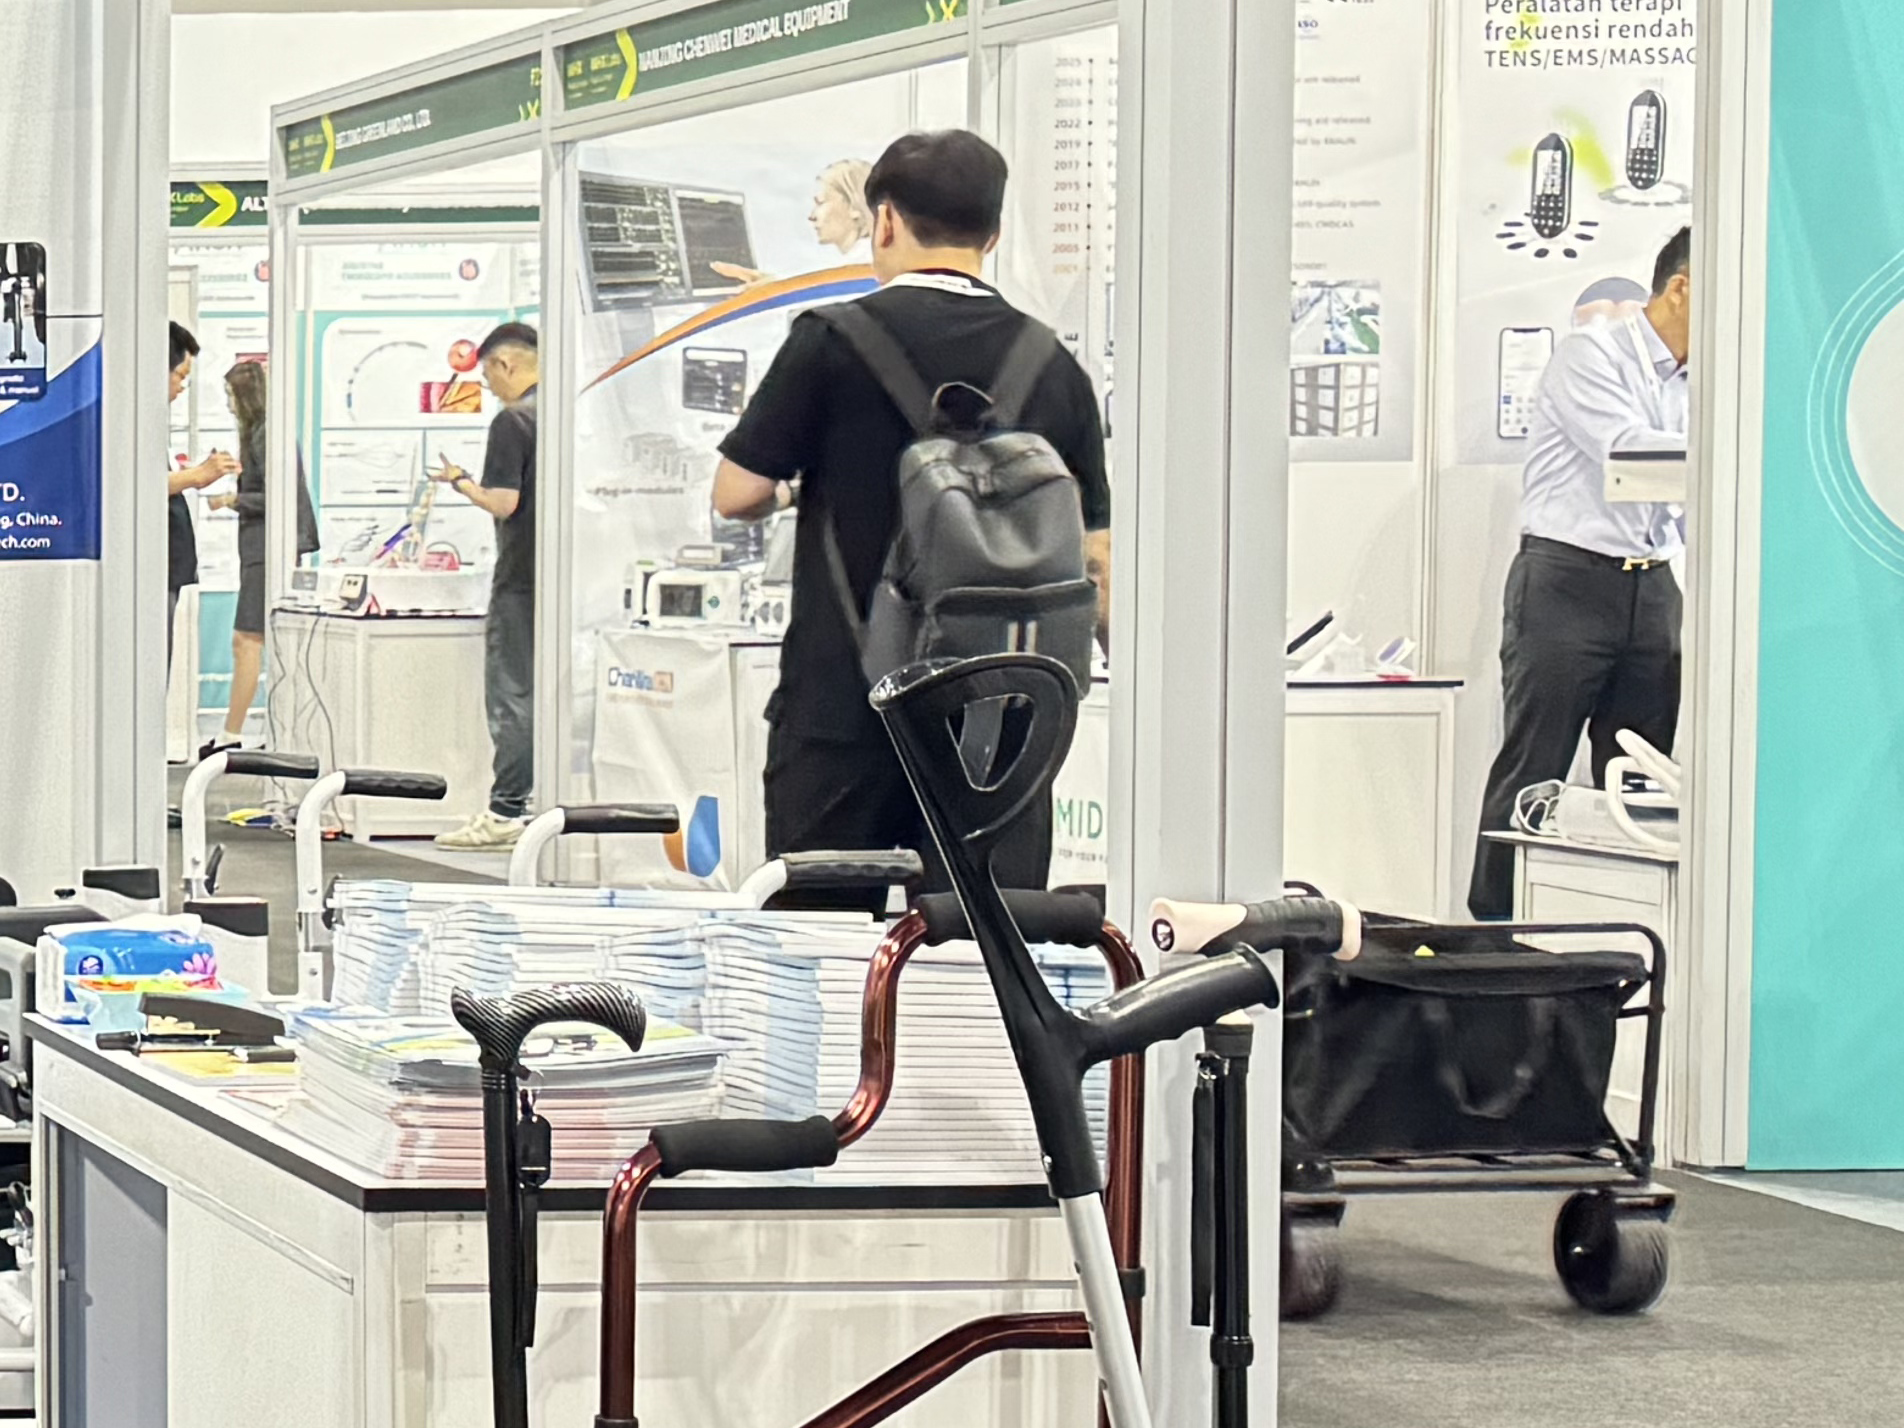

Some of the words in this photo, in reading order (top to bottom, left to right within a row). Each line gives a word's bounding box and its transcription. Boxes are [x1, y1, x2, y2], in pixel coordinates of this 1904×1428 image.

[1485, 19, 1599, 41] frekuensi
[1608, 18, 1694, 39] rendah
[1054, 119, 1081, 129] 2022
[1054, 140, 1081, 150] 2019
[1053, 202, 1080, 212] 2012
[16, 511, 62, 527] China.
